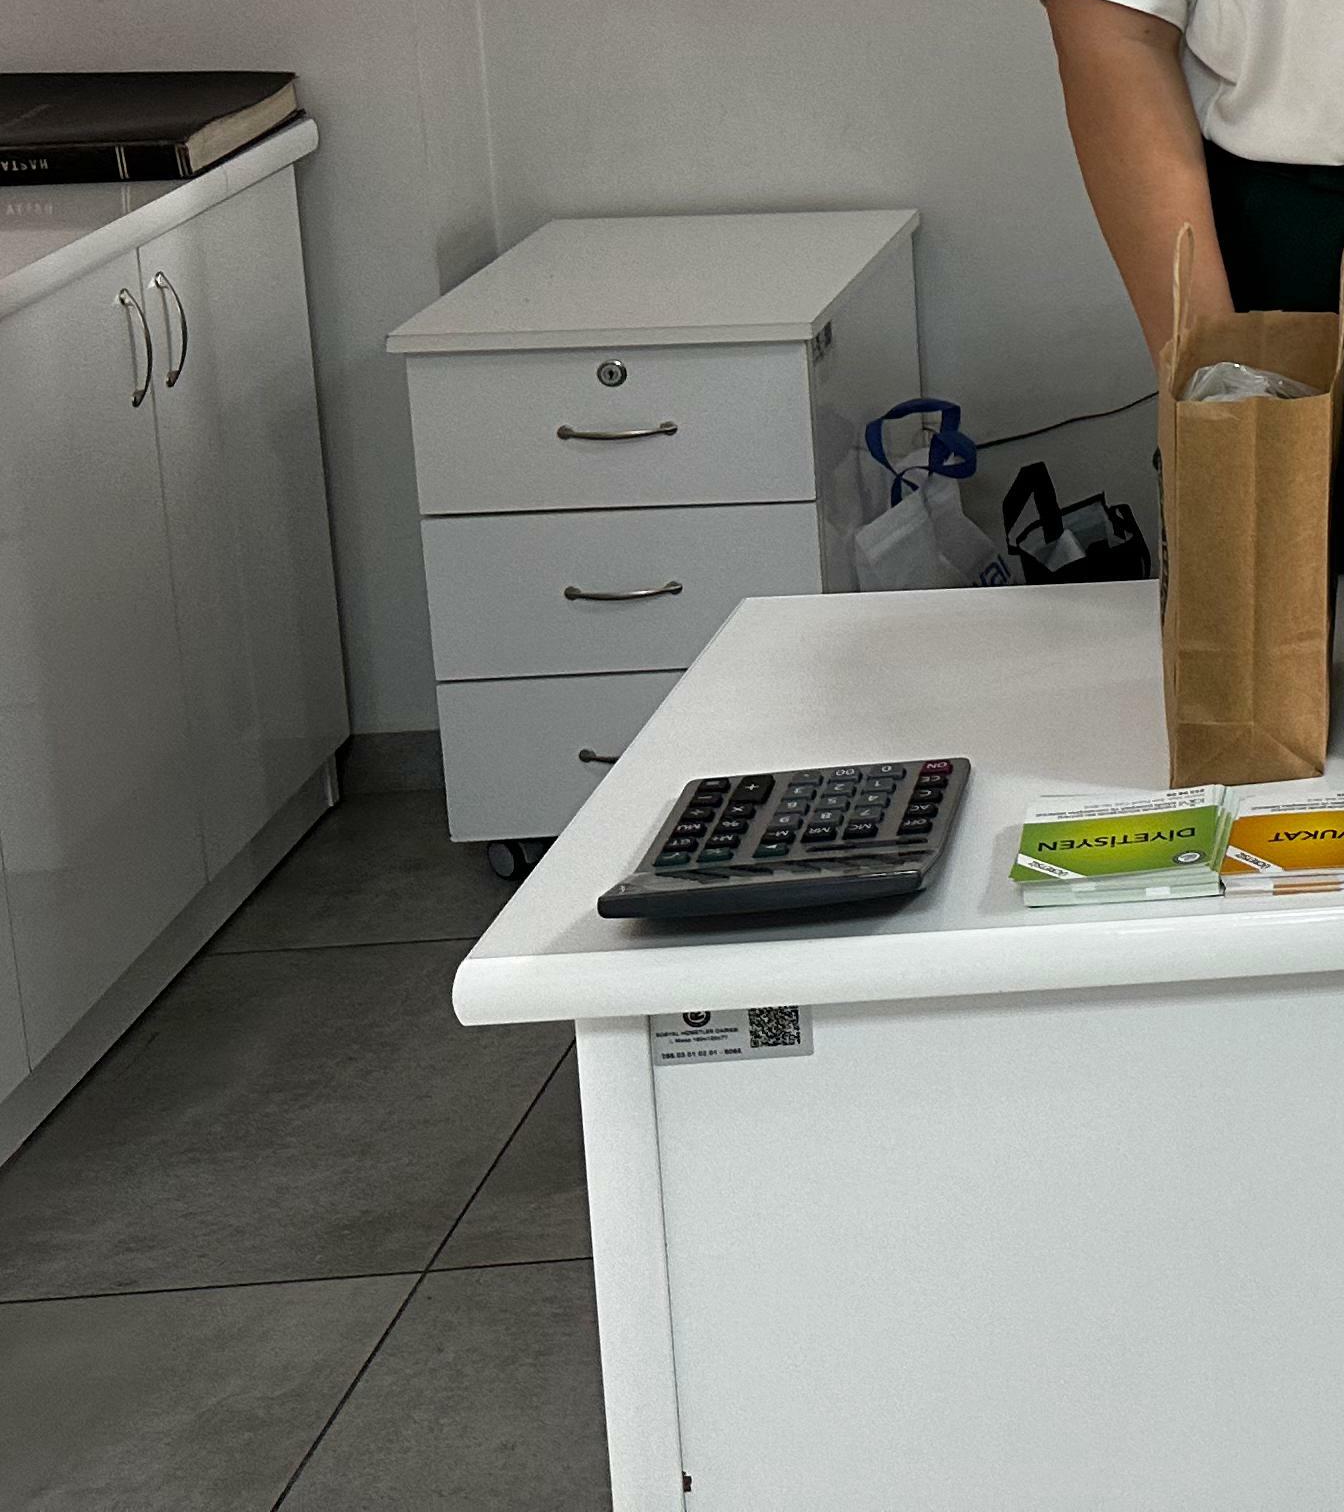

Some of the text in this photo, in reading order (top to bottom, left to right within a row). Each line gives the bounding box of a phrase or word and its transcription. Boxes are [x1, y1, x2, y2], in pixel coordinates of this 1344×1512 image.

[926, 761, 948, 769] ON
[920, 775, 941, 783] CE
[1037, 827, 1196, 851] DİYETİSYEN
